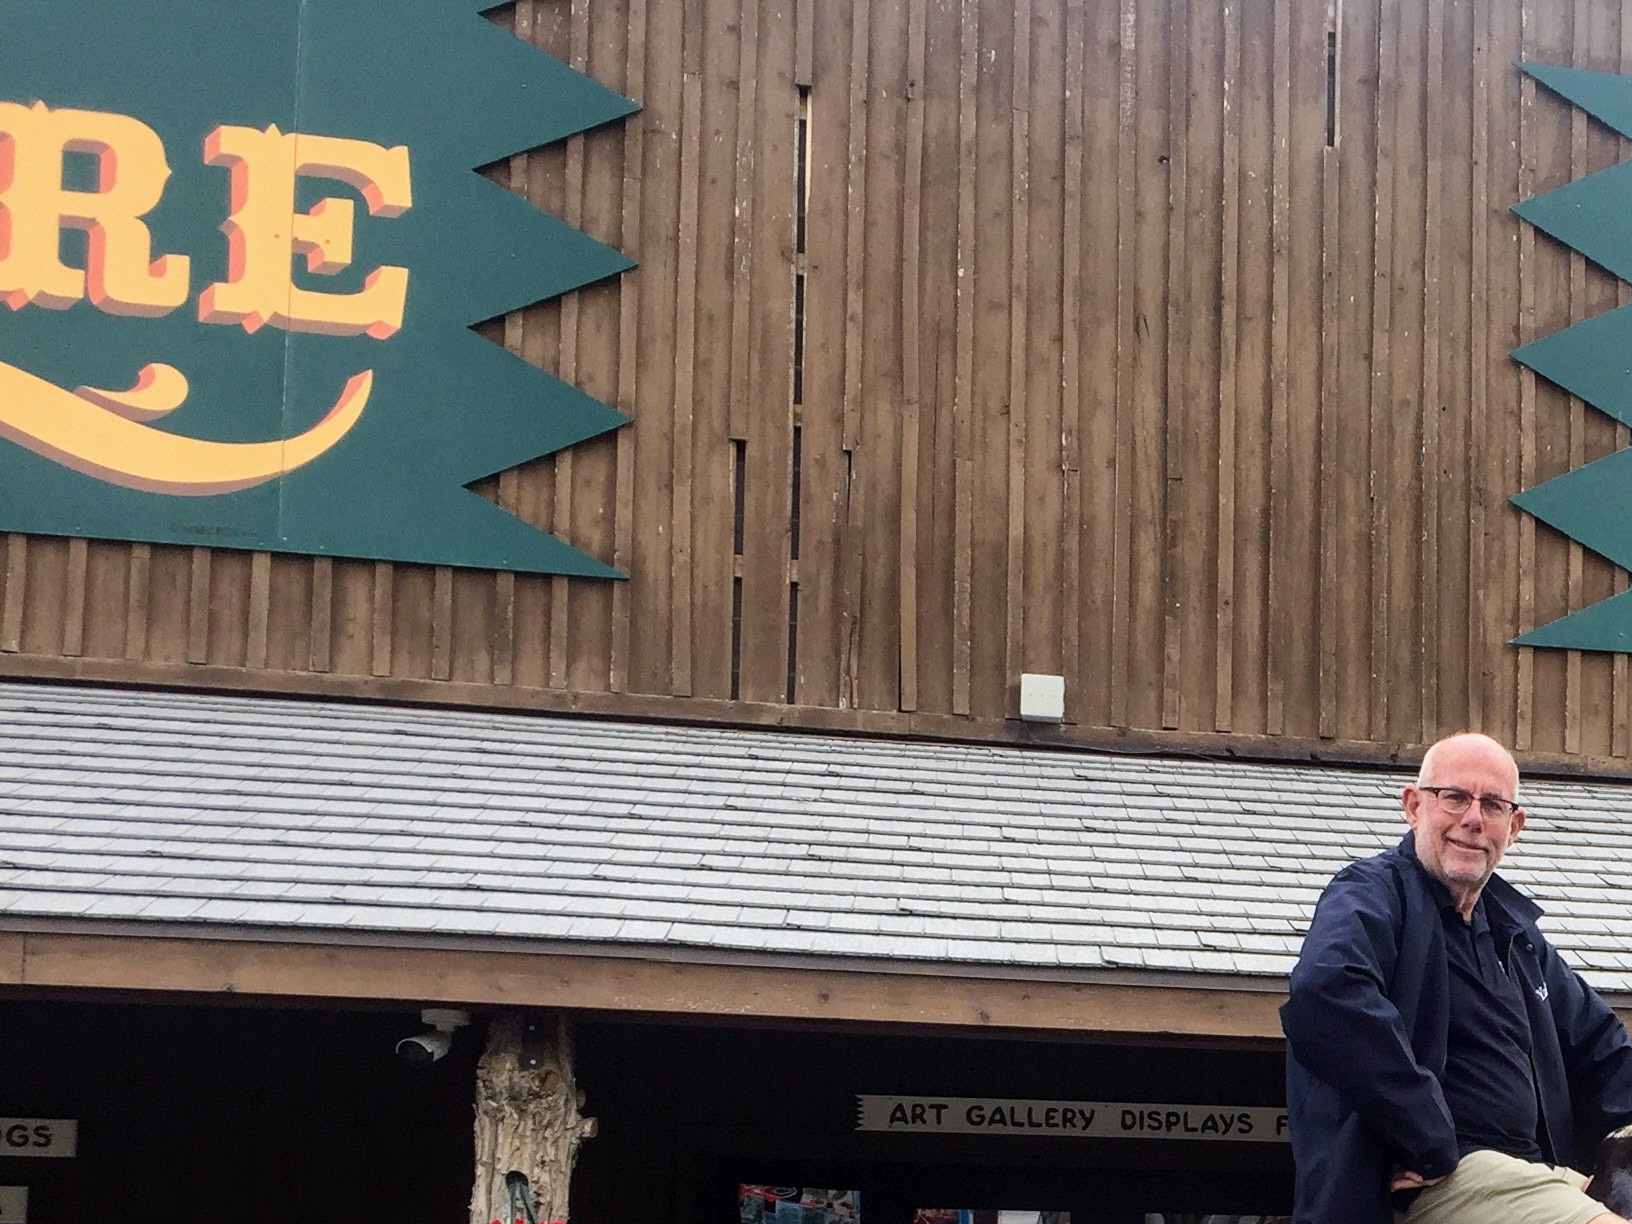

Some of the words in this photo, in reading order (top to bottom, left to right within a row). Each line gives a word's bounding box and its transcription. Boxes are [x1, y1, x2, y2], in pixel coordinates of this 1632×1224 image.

[888, 1103, 949, 1127] ART
[966, 1105, 1096, 1131] GALLERY
[1120, 1109, 1254, 1135] DISPLAYS
[0, 1123, 53, 1148] GS
